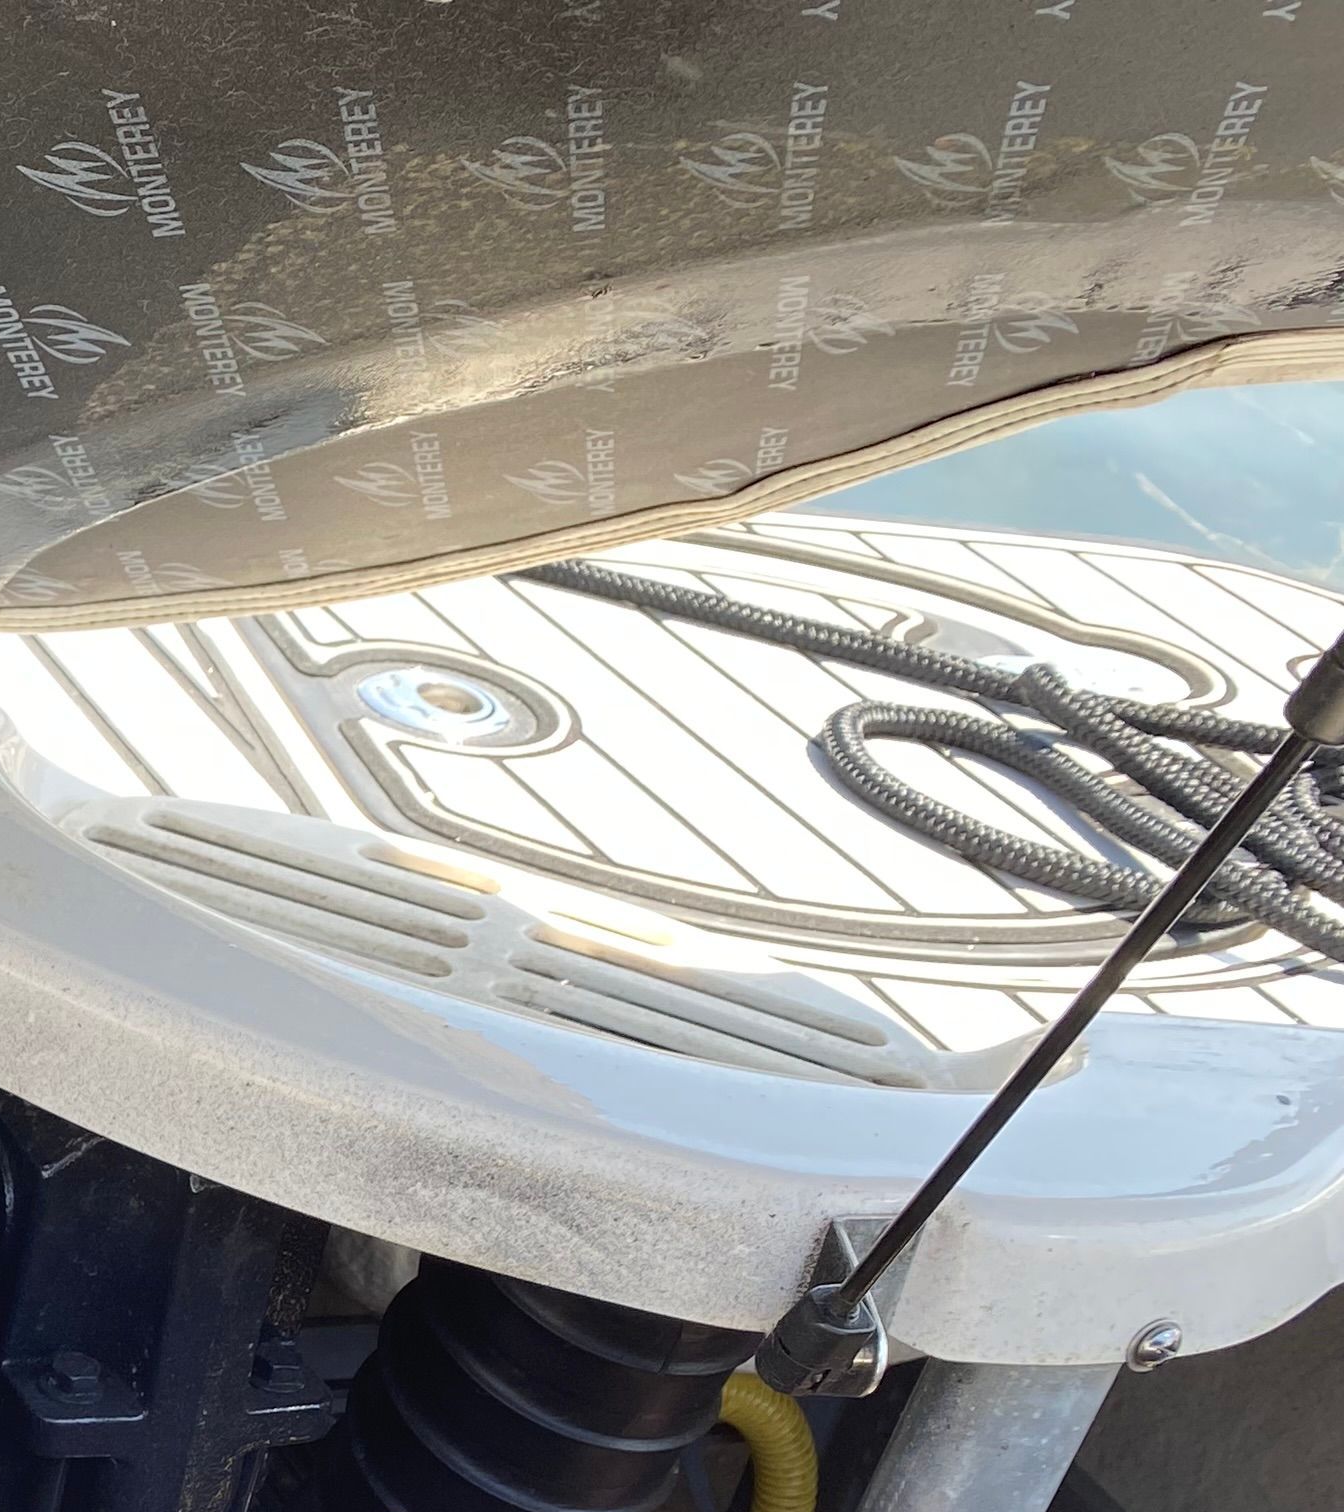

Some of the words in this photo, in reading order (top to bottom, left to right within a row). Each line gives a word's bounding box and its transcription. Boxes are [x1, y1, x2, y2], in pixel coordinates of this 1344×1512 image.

[101, 88, 186, 238] MONTEREY
[332, 85, 396, 236] MONTEREY
[567, 84, 605, 232] MONTEREY
[778, 81, 830, 230] MONTEREY
[980, 79, 1051, 225] MONTEREY
[1178, 80, 1269, 227] MONTEREY
[179, 282, 245, 398] MONTEREY
[768, 275, 810, 391] MONTEREY
[947, 271, 1004, 388] MONTEREY
[411, 430, 449, 520] MONTEREY
[586, 429, 615, 517] MONTEREY
[756, 427, 789, 475] TEREY
